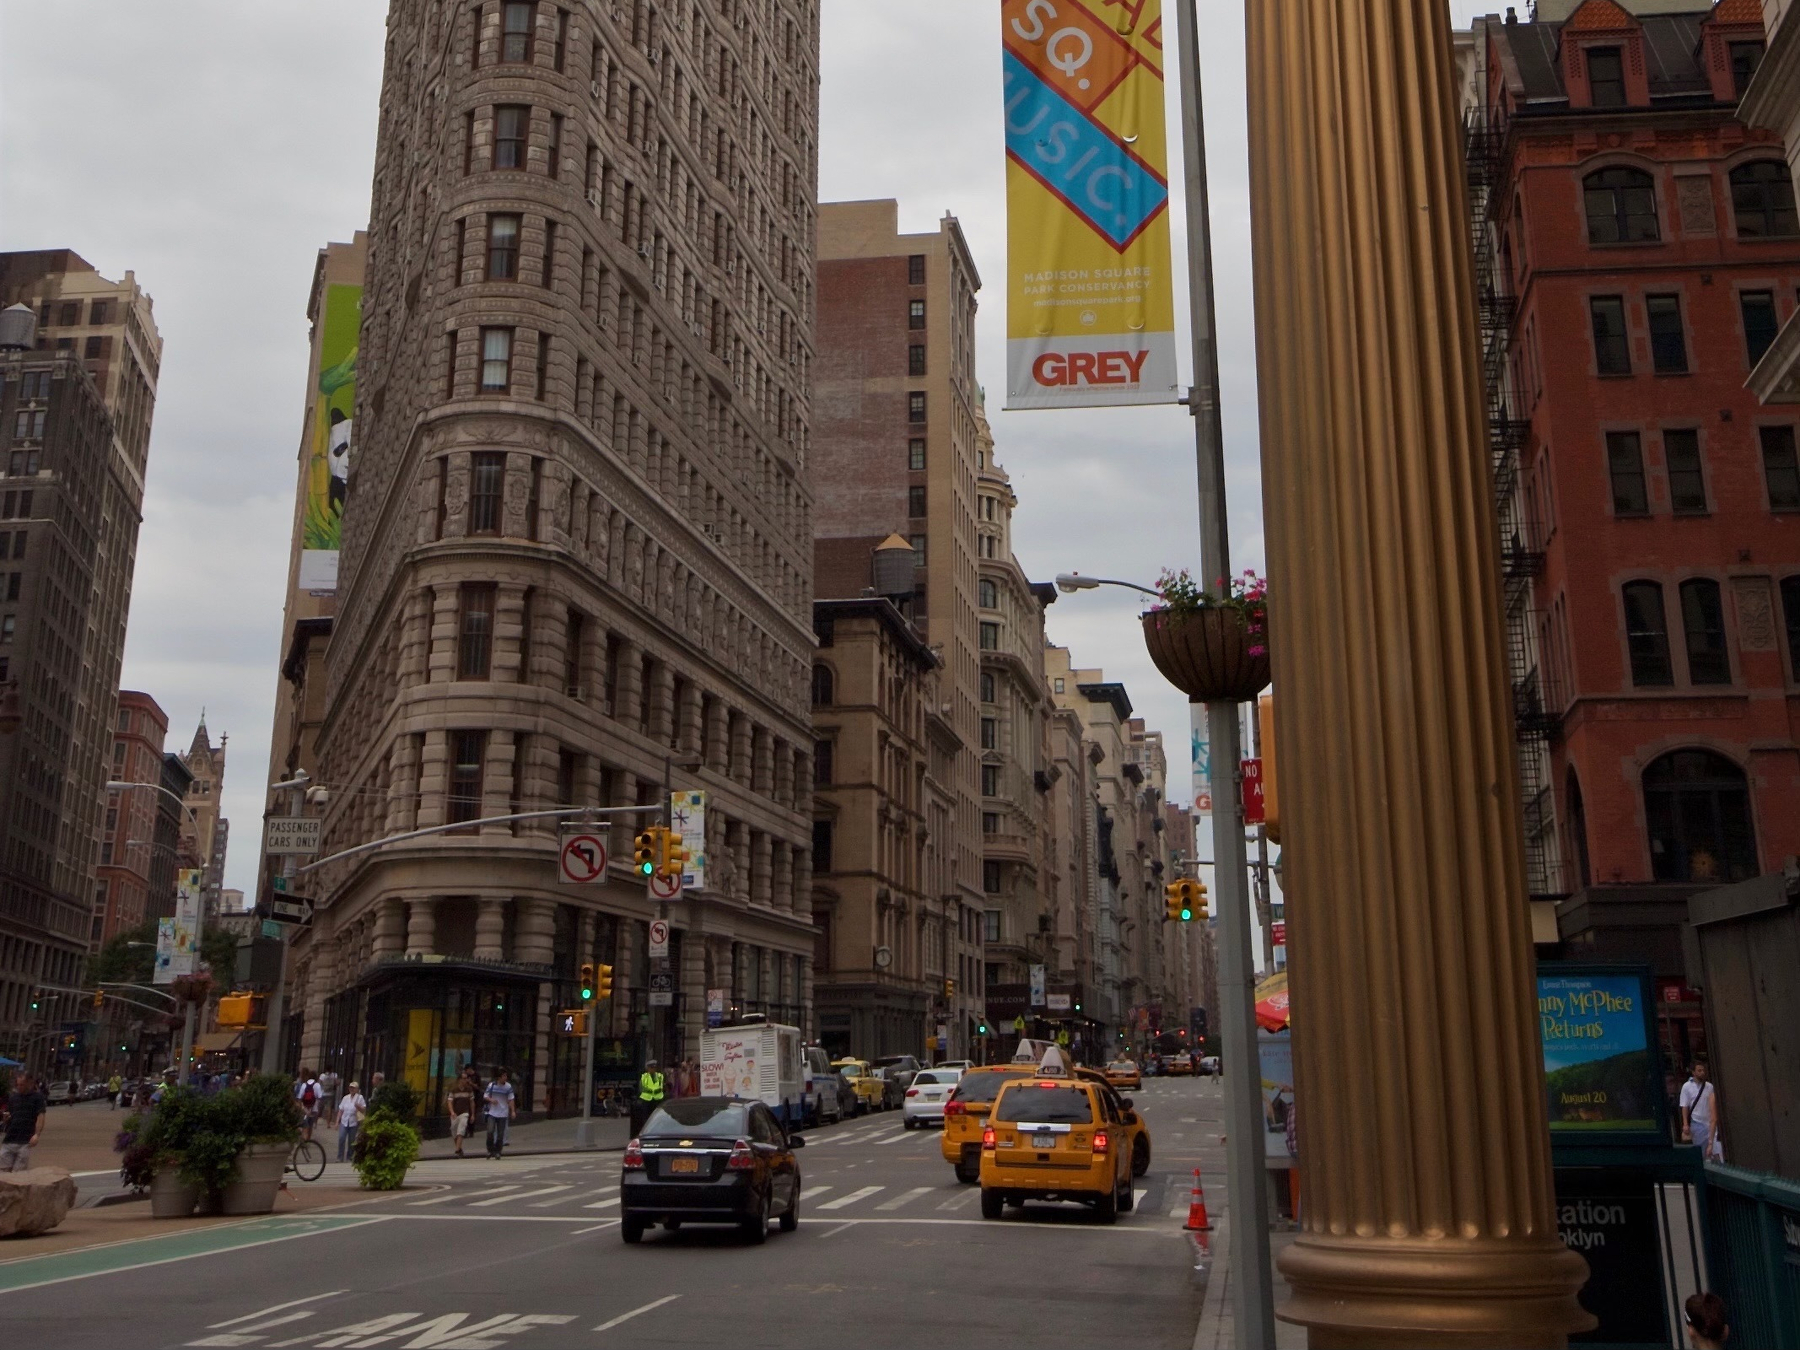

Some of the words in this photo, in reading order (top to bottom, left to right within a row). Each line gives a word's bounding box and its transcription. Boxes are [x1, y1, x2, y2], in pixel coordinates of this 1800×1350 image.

[1003, 71, 1132, 227] USIC.
[1024, 269, 1089, 283] MADISON
[1094, 266, 1151, 279] SQUARE
[1024, 284, 1054, 295] PARK
[1059, 280, 1151, 293] CONSERVANCY
[1033, 295, 1142, 307] madisonsquarepark.org
[1032, 350, 1150, 387] GREY
[1245, 765, 1258, 778] NO
[270, 822, 319, 833] PASSENGER
[269, 837, 291, 848] CARS
[296, 837, 318, 848] ONLY
[278, 903, 288, 913] ONE
[1569, 990, 1633, 1017] McPhee
[1541, 1014, 1604, 1041] Returns
[1561, 1092, 1591, 1104] August
[1594, 1091, 1607, 1104] 20
